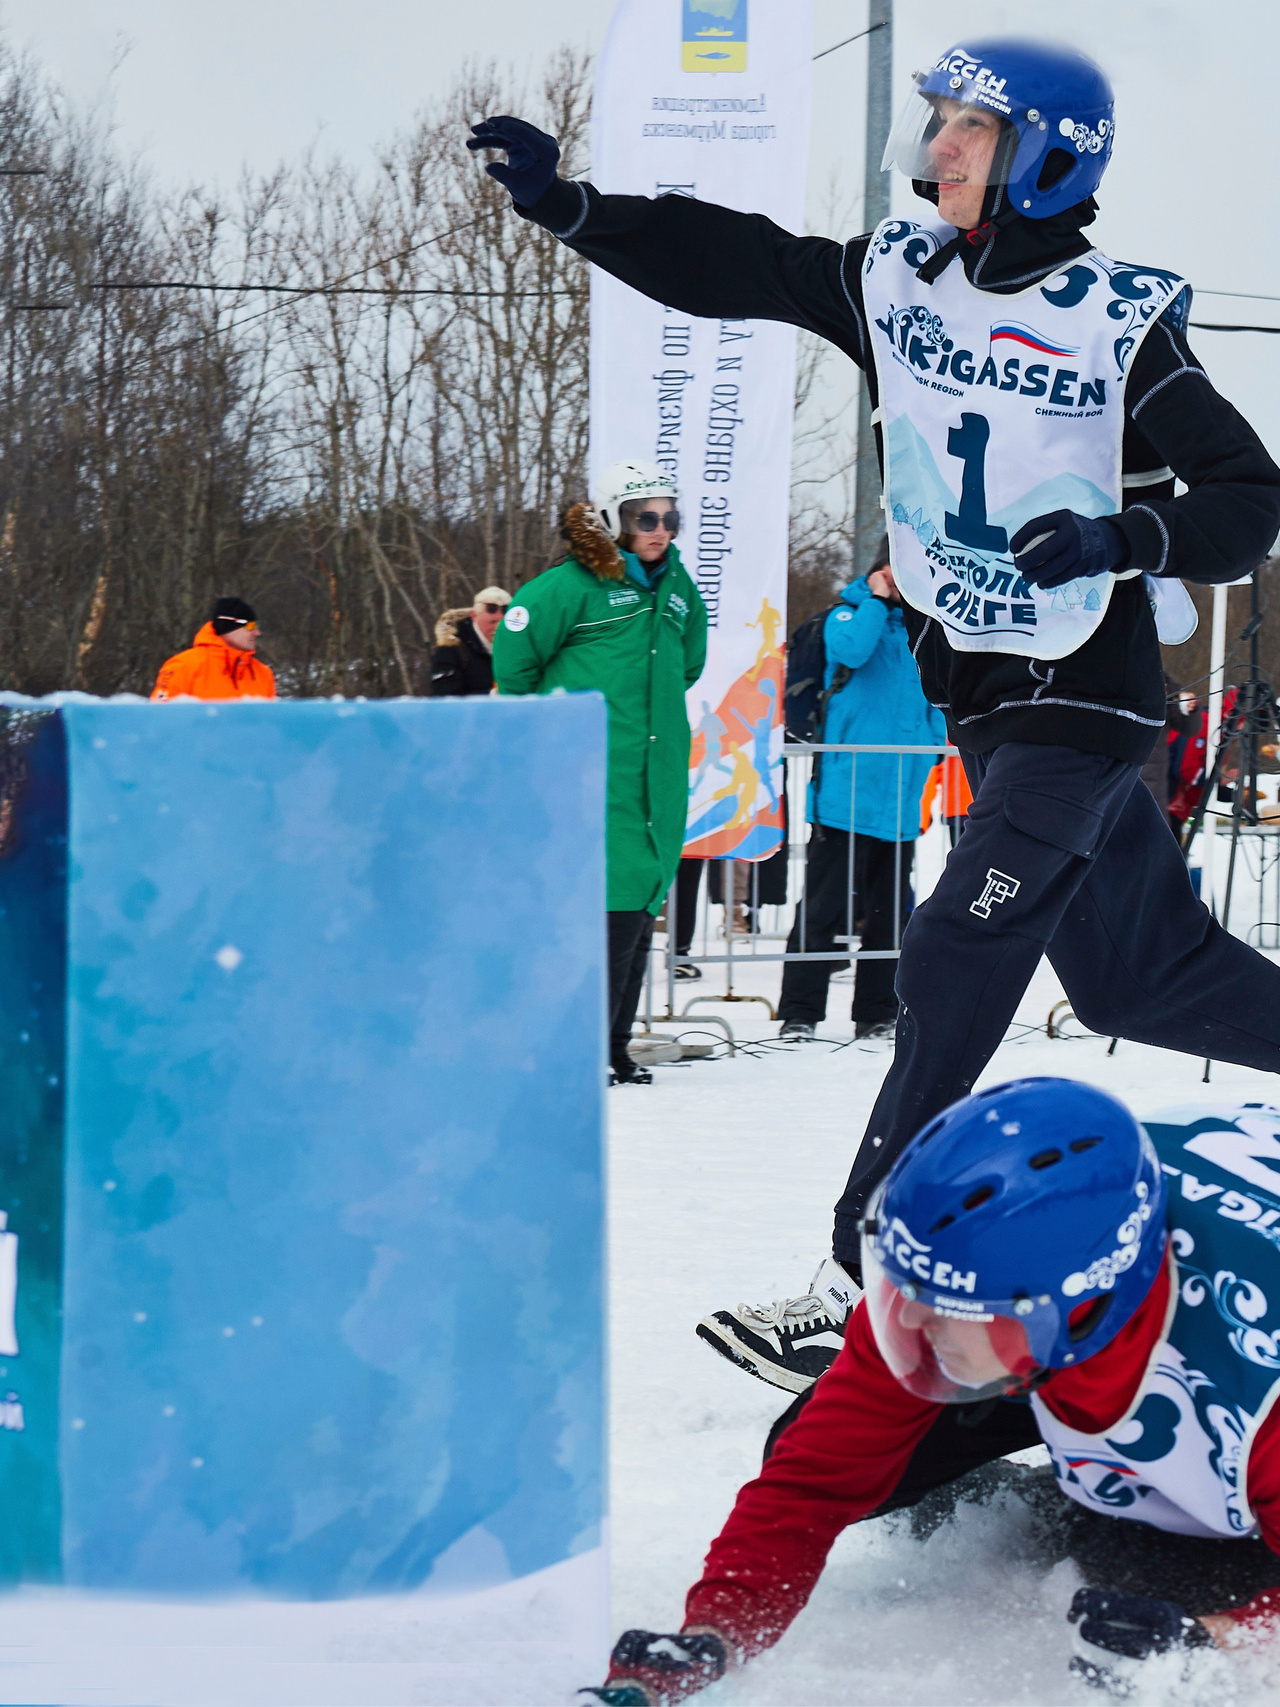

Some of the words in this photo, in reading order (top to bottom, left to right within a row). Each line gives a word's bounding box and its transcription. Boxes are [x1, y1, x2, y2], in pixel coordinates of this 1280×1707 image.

[975, 84, 1009, 103] ПЕРВЫЕ
[978, 94, 1012, 115] РОССИИ
[930, 381, 965, 398] REGION
[1034, 407, 1084, 419] СНЕЖНЫЙ
[1085, 408, 1103, 418] БОЙ
[945, 412, 1009, 554] 1
[935, 582, 1037, 627] СНЕГЕ
[969, 867, 1021, 919] F
[827, 1286, 846, 1304] PUMA
